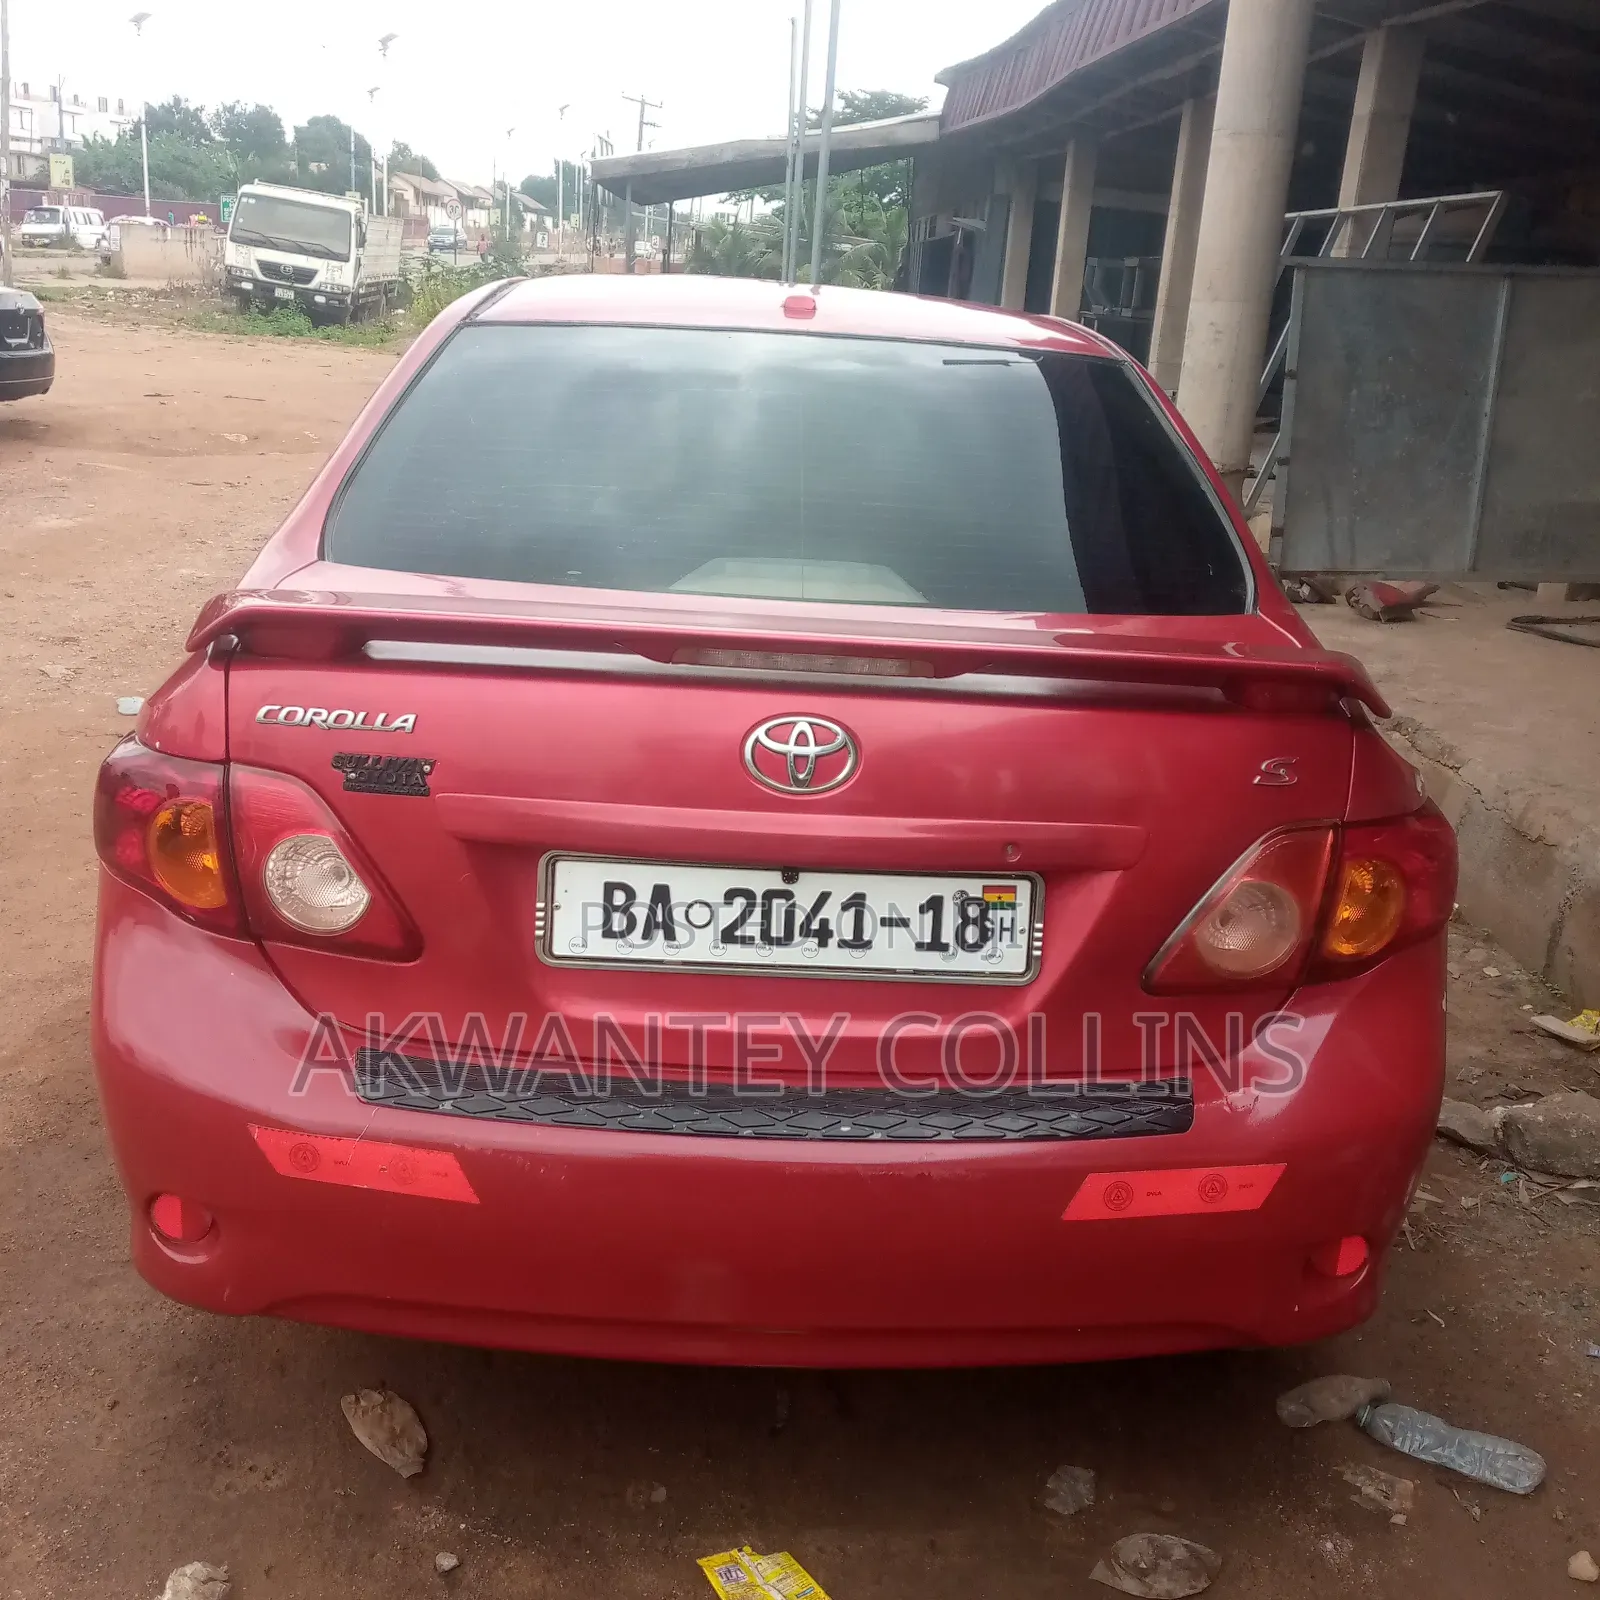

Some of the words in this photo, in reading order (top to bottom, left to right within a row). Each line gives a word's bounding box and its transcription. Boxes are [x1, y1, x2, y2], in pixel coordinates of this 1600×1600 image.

[255, 705, 418, 734] COROLLA
[1252, 757, 1299, 786] S
[601, 881, 677, 942] BA
[721, 887, 990, 953] 2041-18
